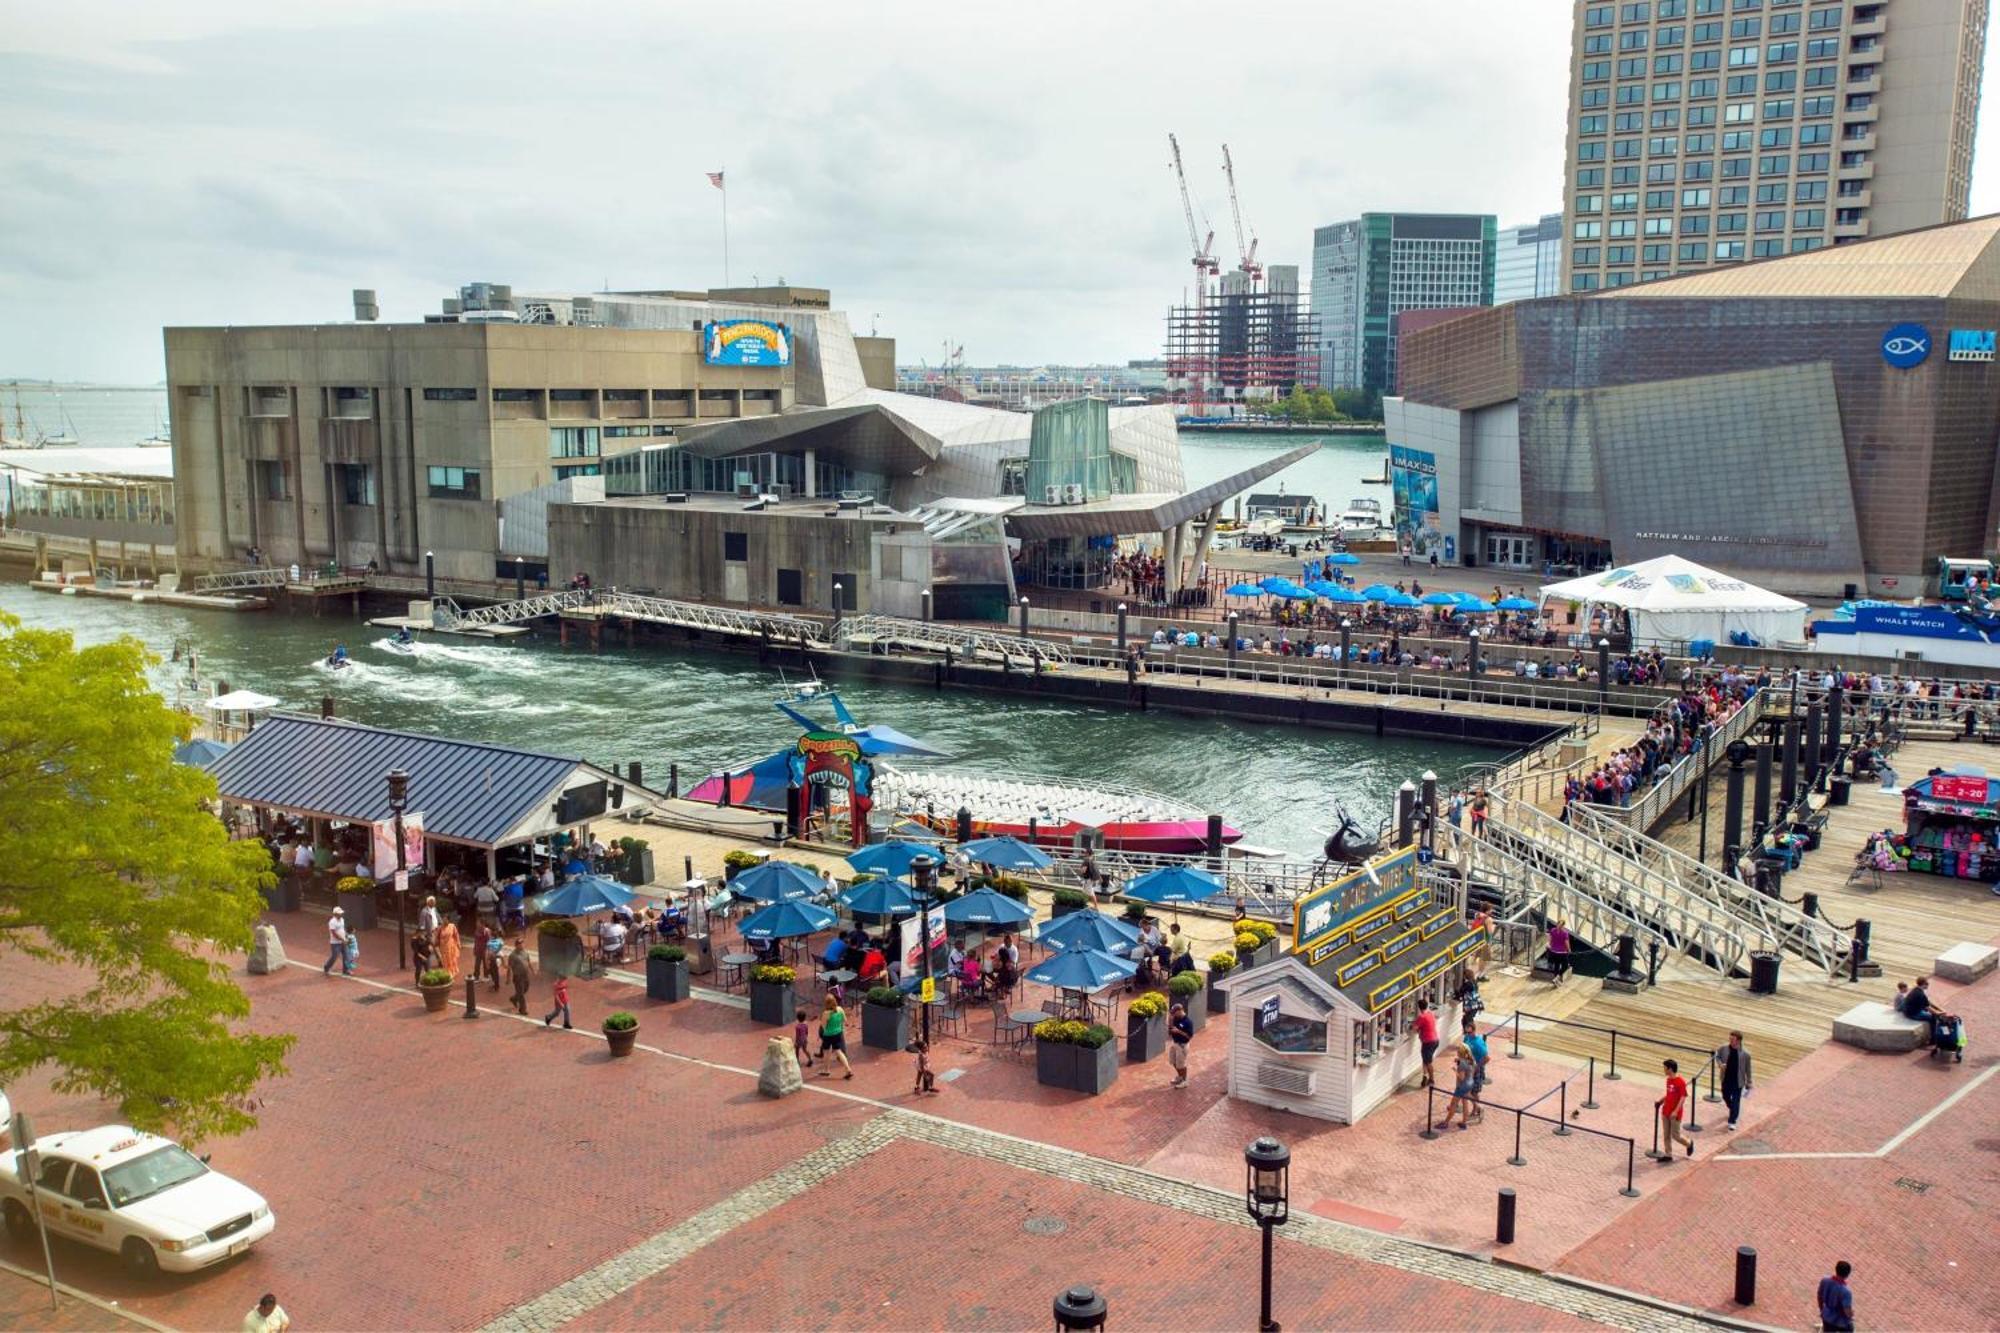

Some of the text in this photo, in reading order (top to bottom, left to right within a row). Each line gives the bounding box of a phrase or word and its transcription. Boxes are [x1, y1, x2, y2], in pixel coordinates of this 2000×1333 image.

[1950, 330, 1996, 351] IMAX
[1952, 351, 1995, 359] THEATRE
[1395, 458, 1436, 473] IMAX 3D
[1635, 532, 1680, 540] MATTHEW
[1875, 616, 1945, 628] WHALE WATCH
[1263, 1009, 1278, 1024] ATM
